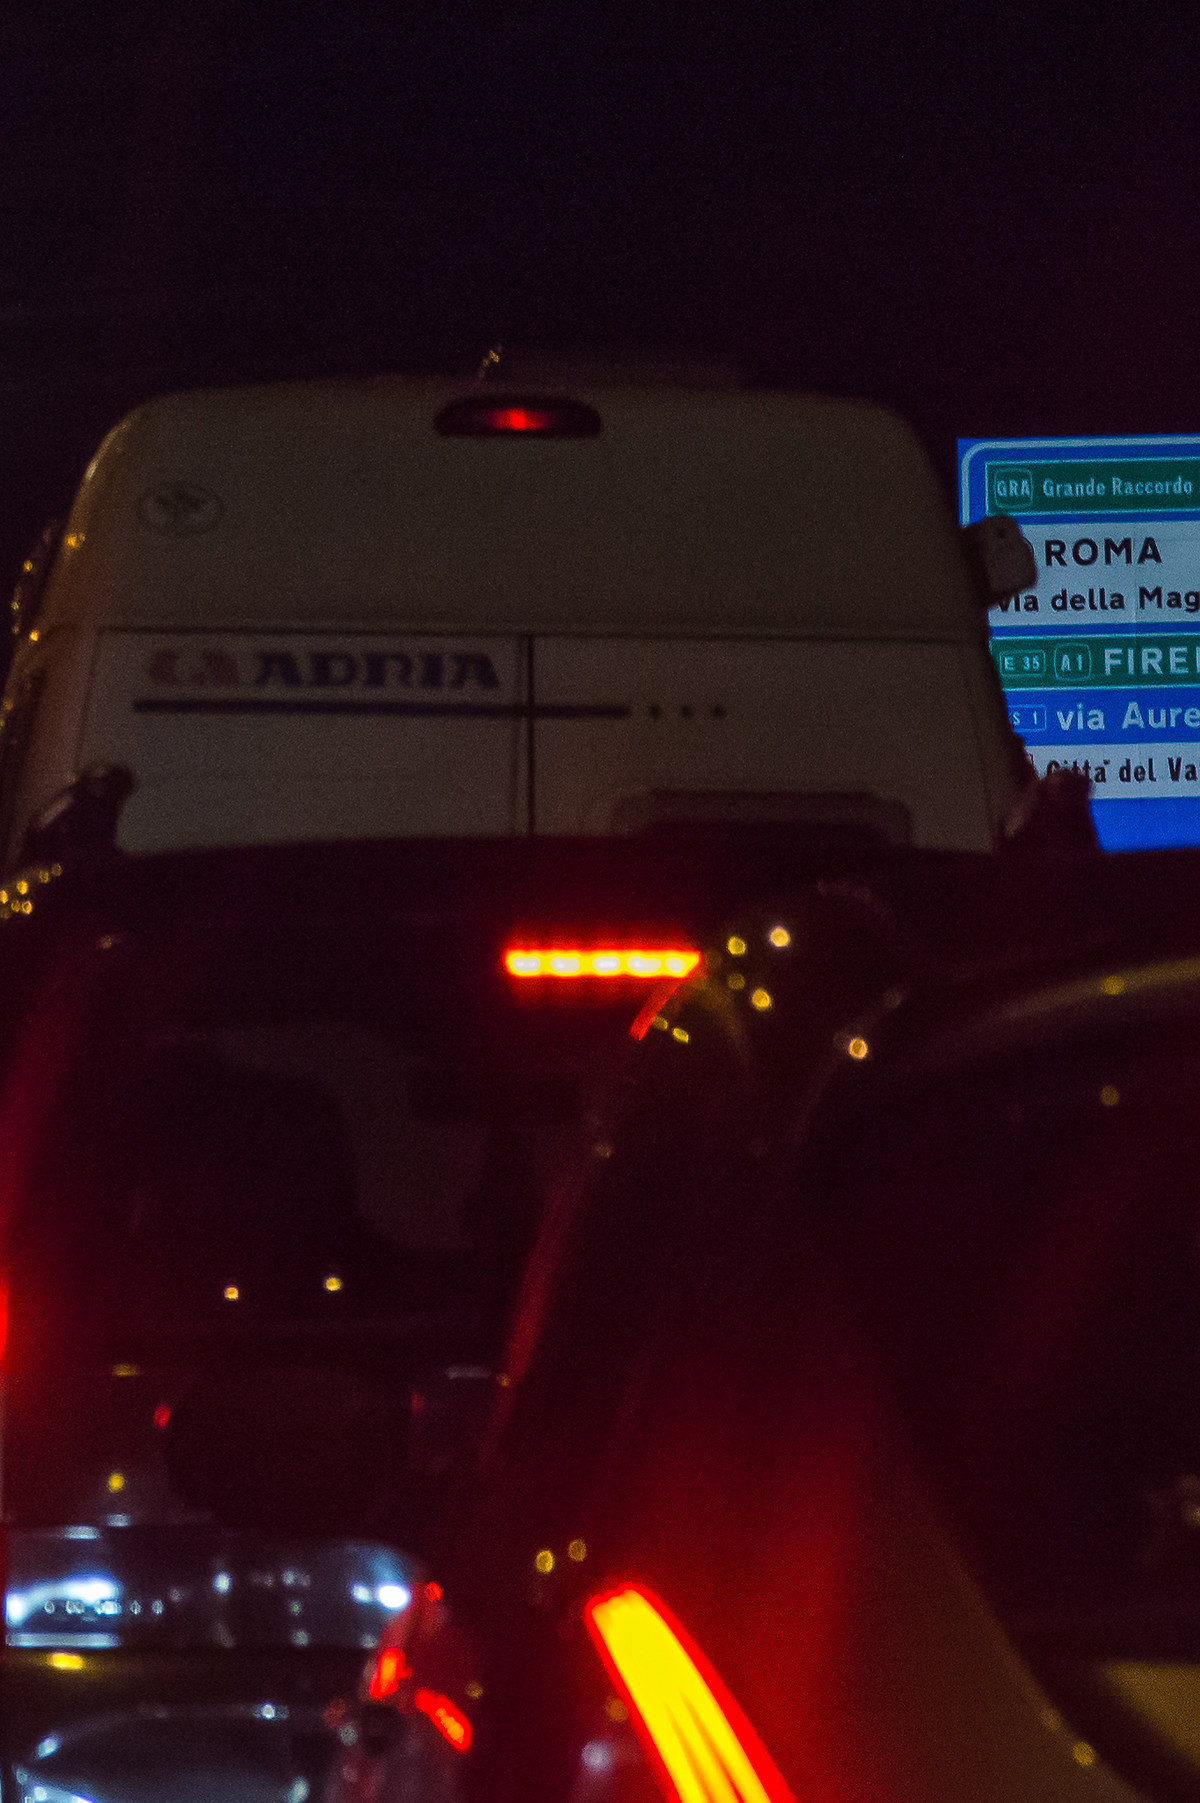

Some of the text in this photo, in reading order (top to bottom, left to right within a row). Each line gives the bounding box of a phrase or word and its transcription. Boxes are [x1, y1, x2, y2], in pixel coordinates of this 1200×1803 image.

[997, 478, 1031, 498] GRA
[1042, 475, 1193, 497] Grande Raccordo
[1045, 536, 1162, 567] ROMA
[1050, 588, 1125, 612] della
[255, 652, 499, 689] ADRIA
[1004, 654, 1040, 671] E 35
[1104, 646, 1200, 676] FIRE
[1056, 701, 1200, 731] via Aure
[1119, 757, 1156, 783] del
